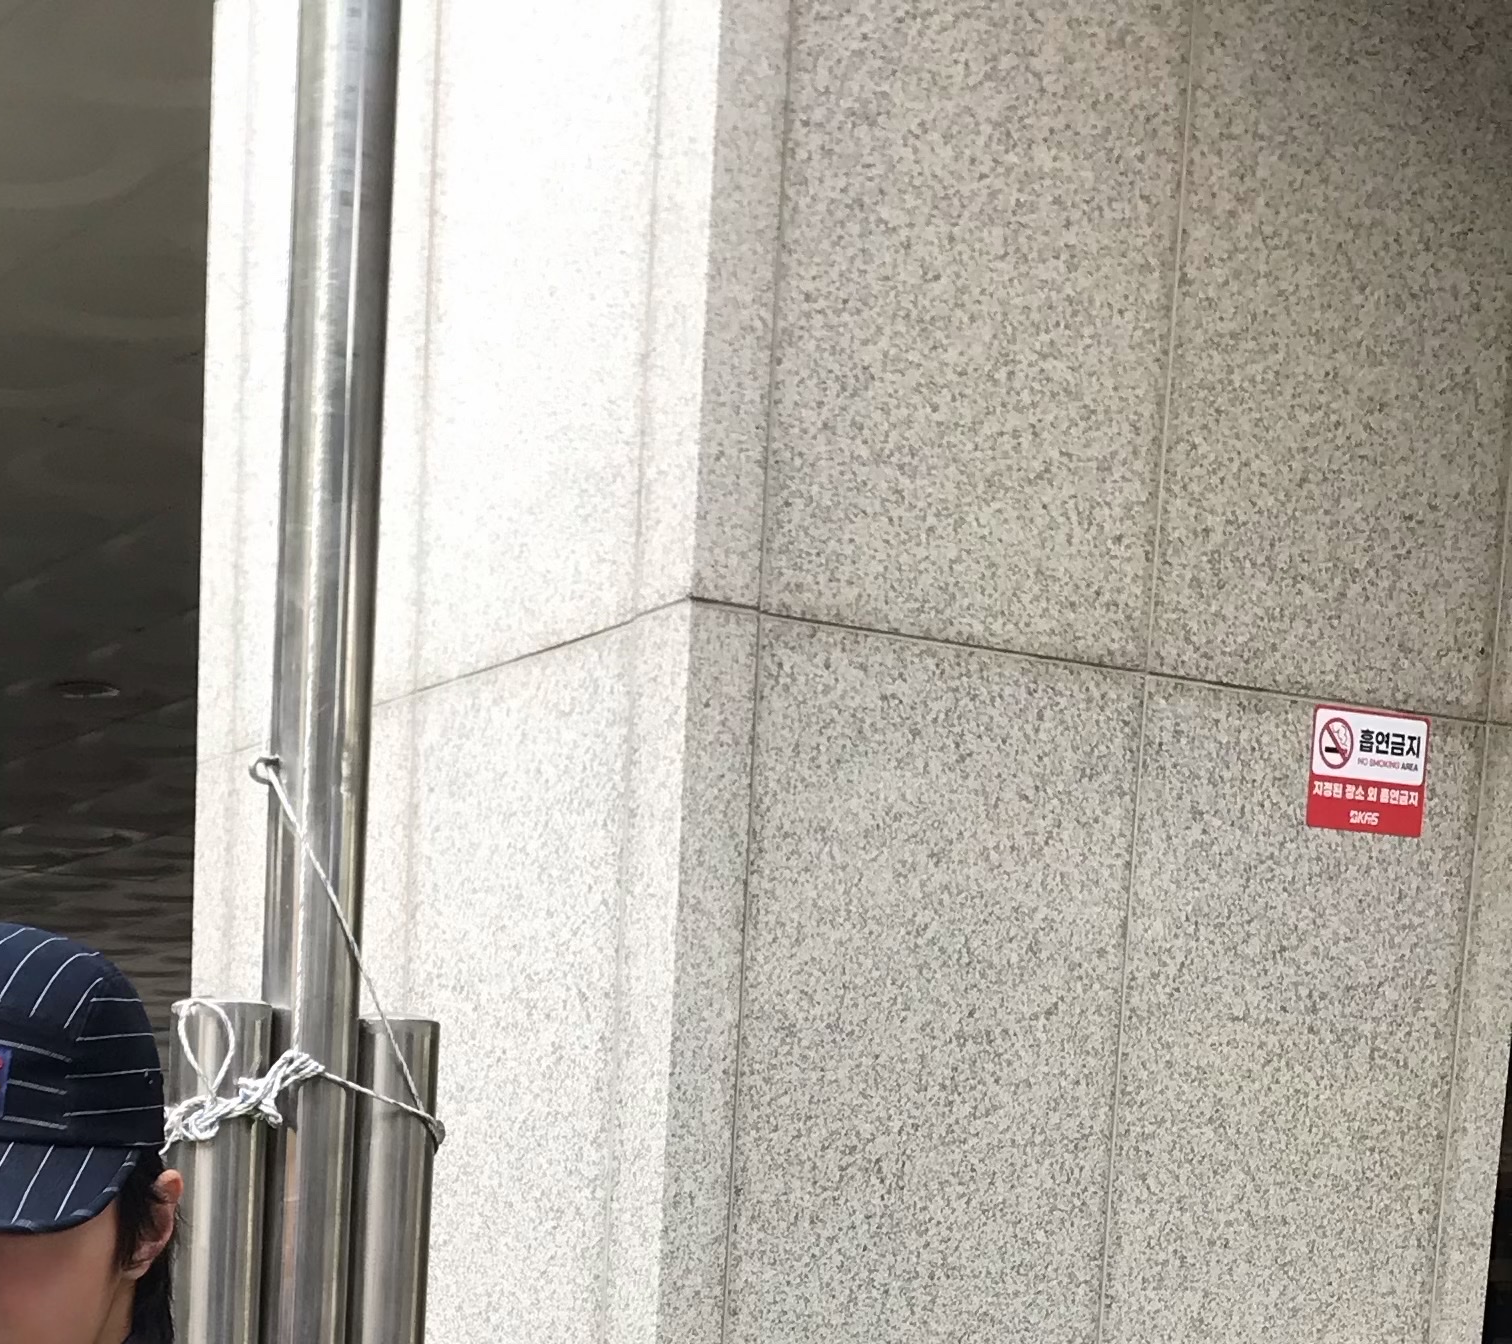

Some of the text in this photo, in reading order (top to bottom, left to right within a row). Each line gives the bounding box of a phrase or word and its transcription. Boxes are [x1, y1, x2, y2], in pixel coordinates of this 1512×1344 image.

[1359, 729, 1421, 758] 흡연금지
[1357, 757, 1419, 771] NO SMOKING AREA
[1313, 781, 1419, 807] 지정된 장소 외 흡연금지
